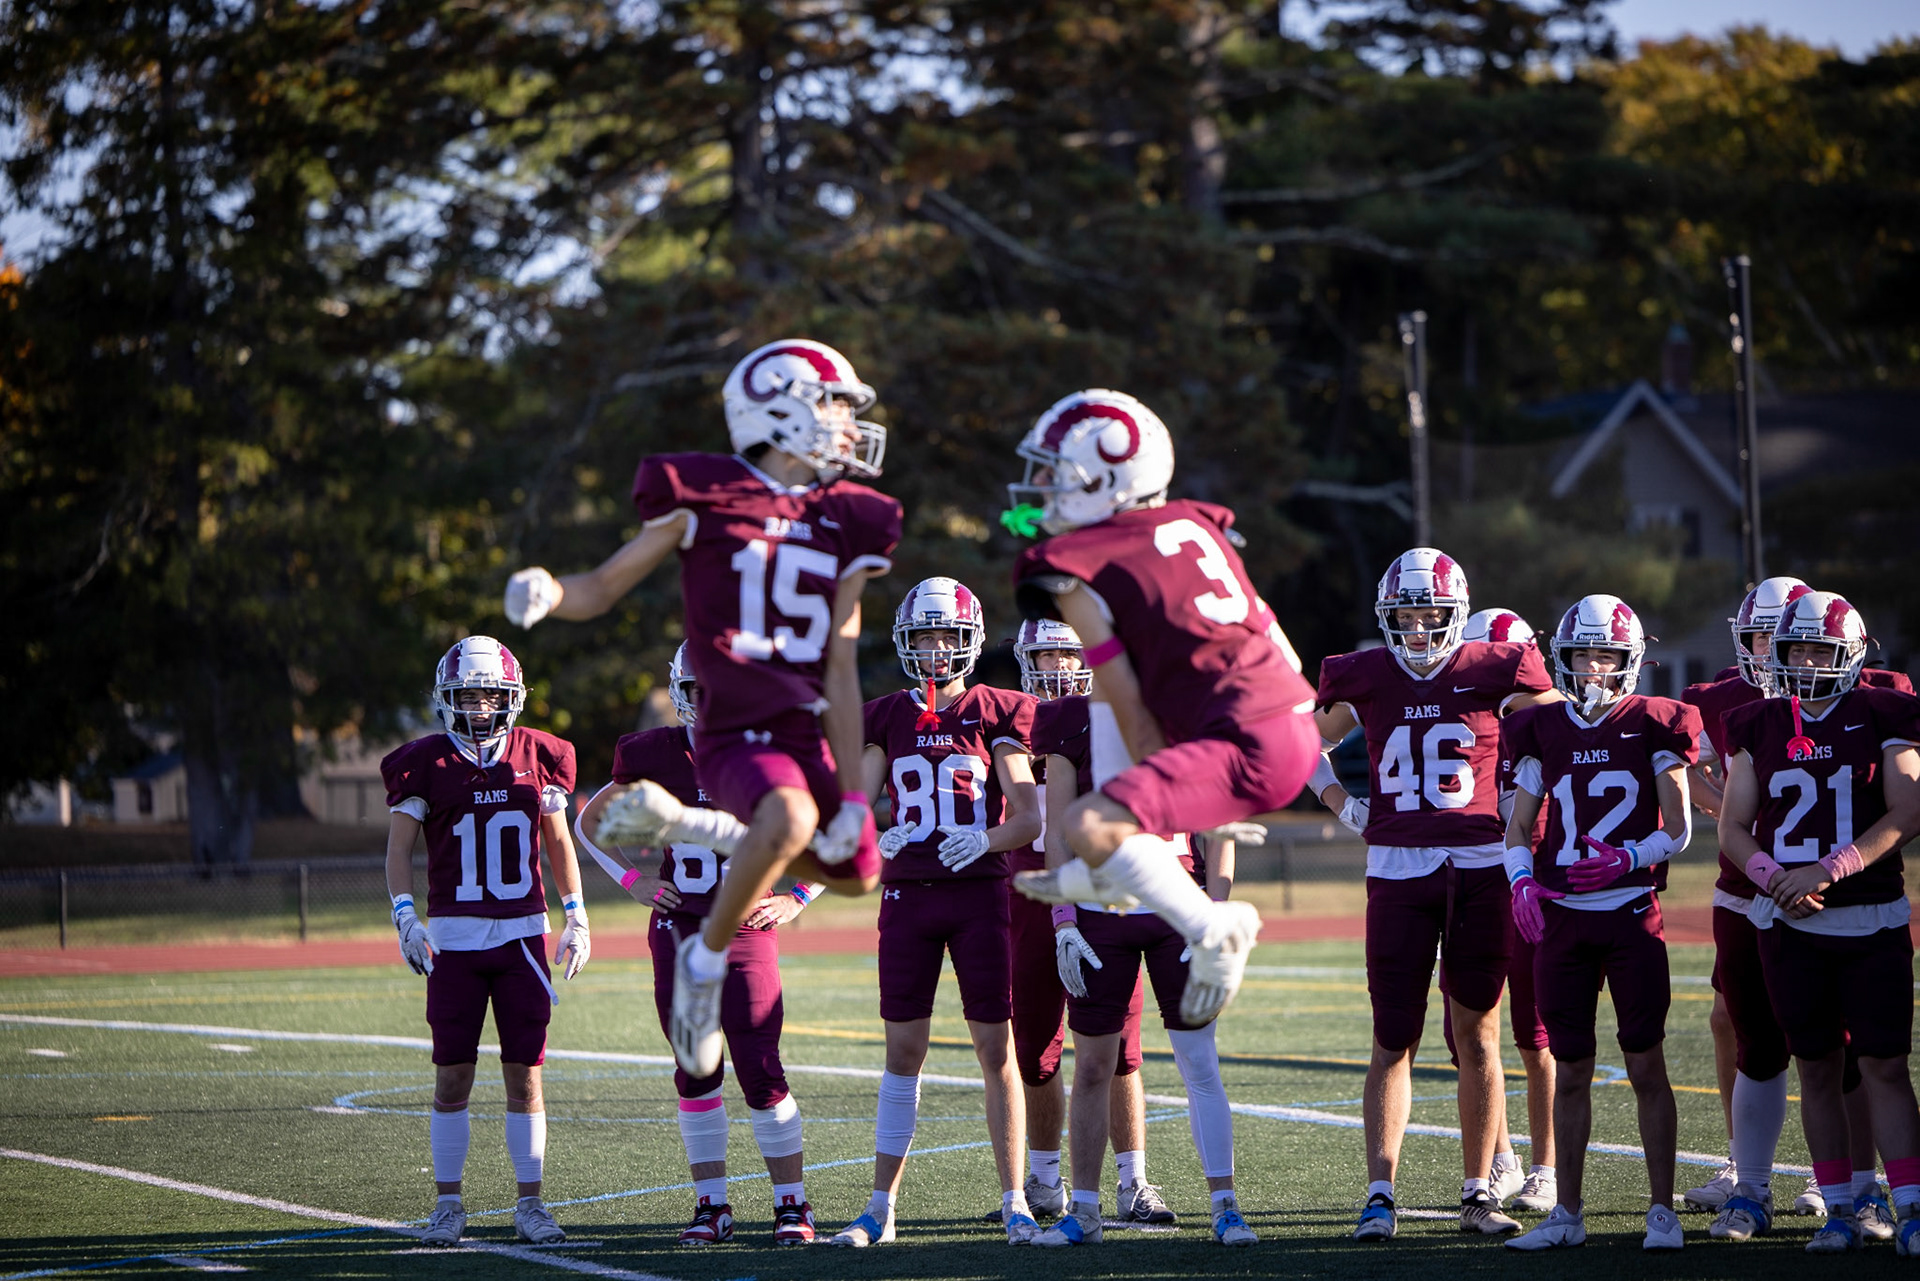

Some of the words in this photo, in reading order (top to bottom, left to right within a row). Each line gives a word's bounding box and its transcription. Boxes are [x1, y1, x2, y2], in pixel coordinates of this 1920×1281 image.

[764, 516, 812, 541] RAMS
[731, 538, 839, 663] 15
[1154, 518, 1250, 626] 3
[1579, 632, 1605, 641] Riddell
[1792, 627, 1819, 635] Riddell
[1404, 704, 1441, 720] RAMS
[916, 734, 954, 748] RAMS
[1378, 722, 1476, 812] 46
[1572, 749, 1610, 765] RAMS
[473, 789, 509, 805] RAMS
[892, 753, 988, 843] 80
[1552, 769, 1640, 867] 12
[1768, 764, 1854, 864] 21
[452, 809, 534, 902] 10
